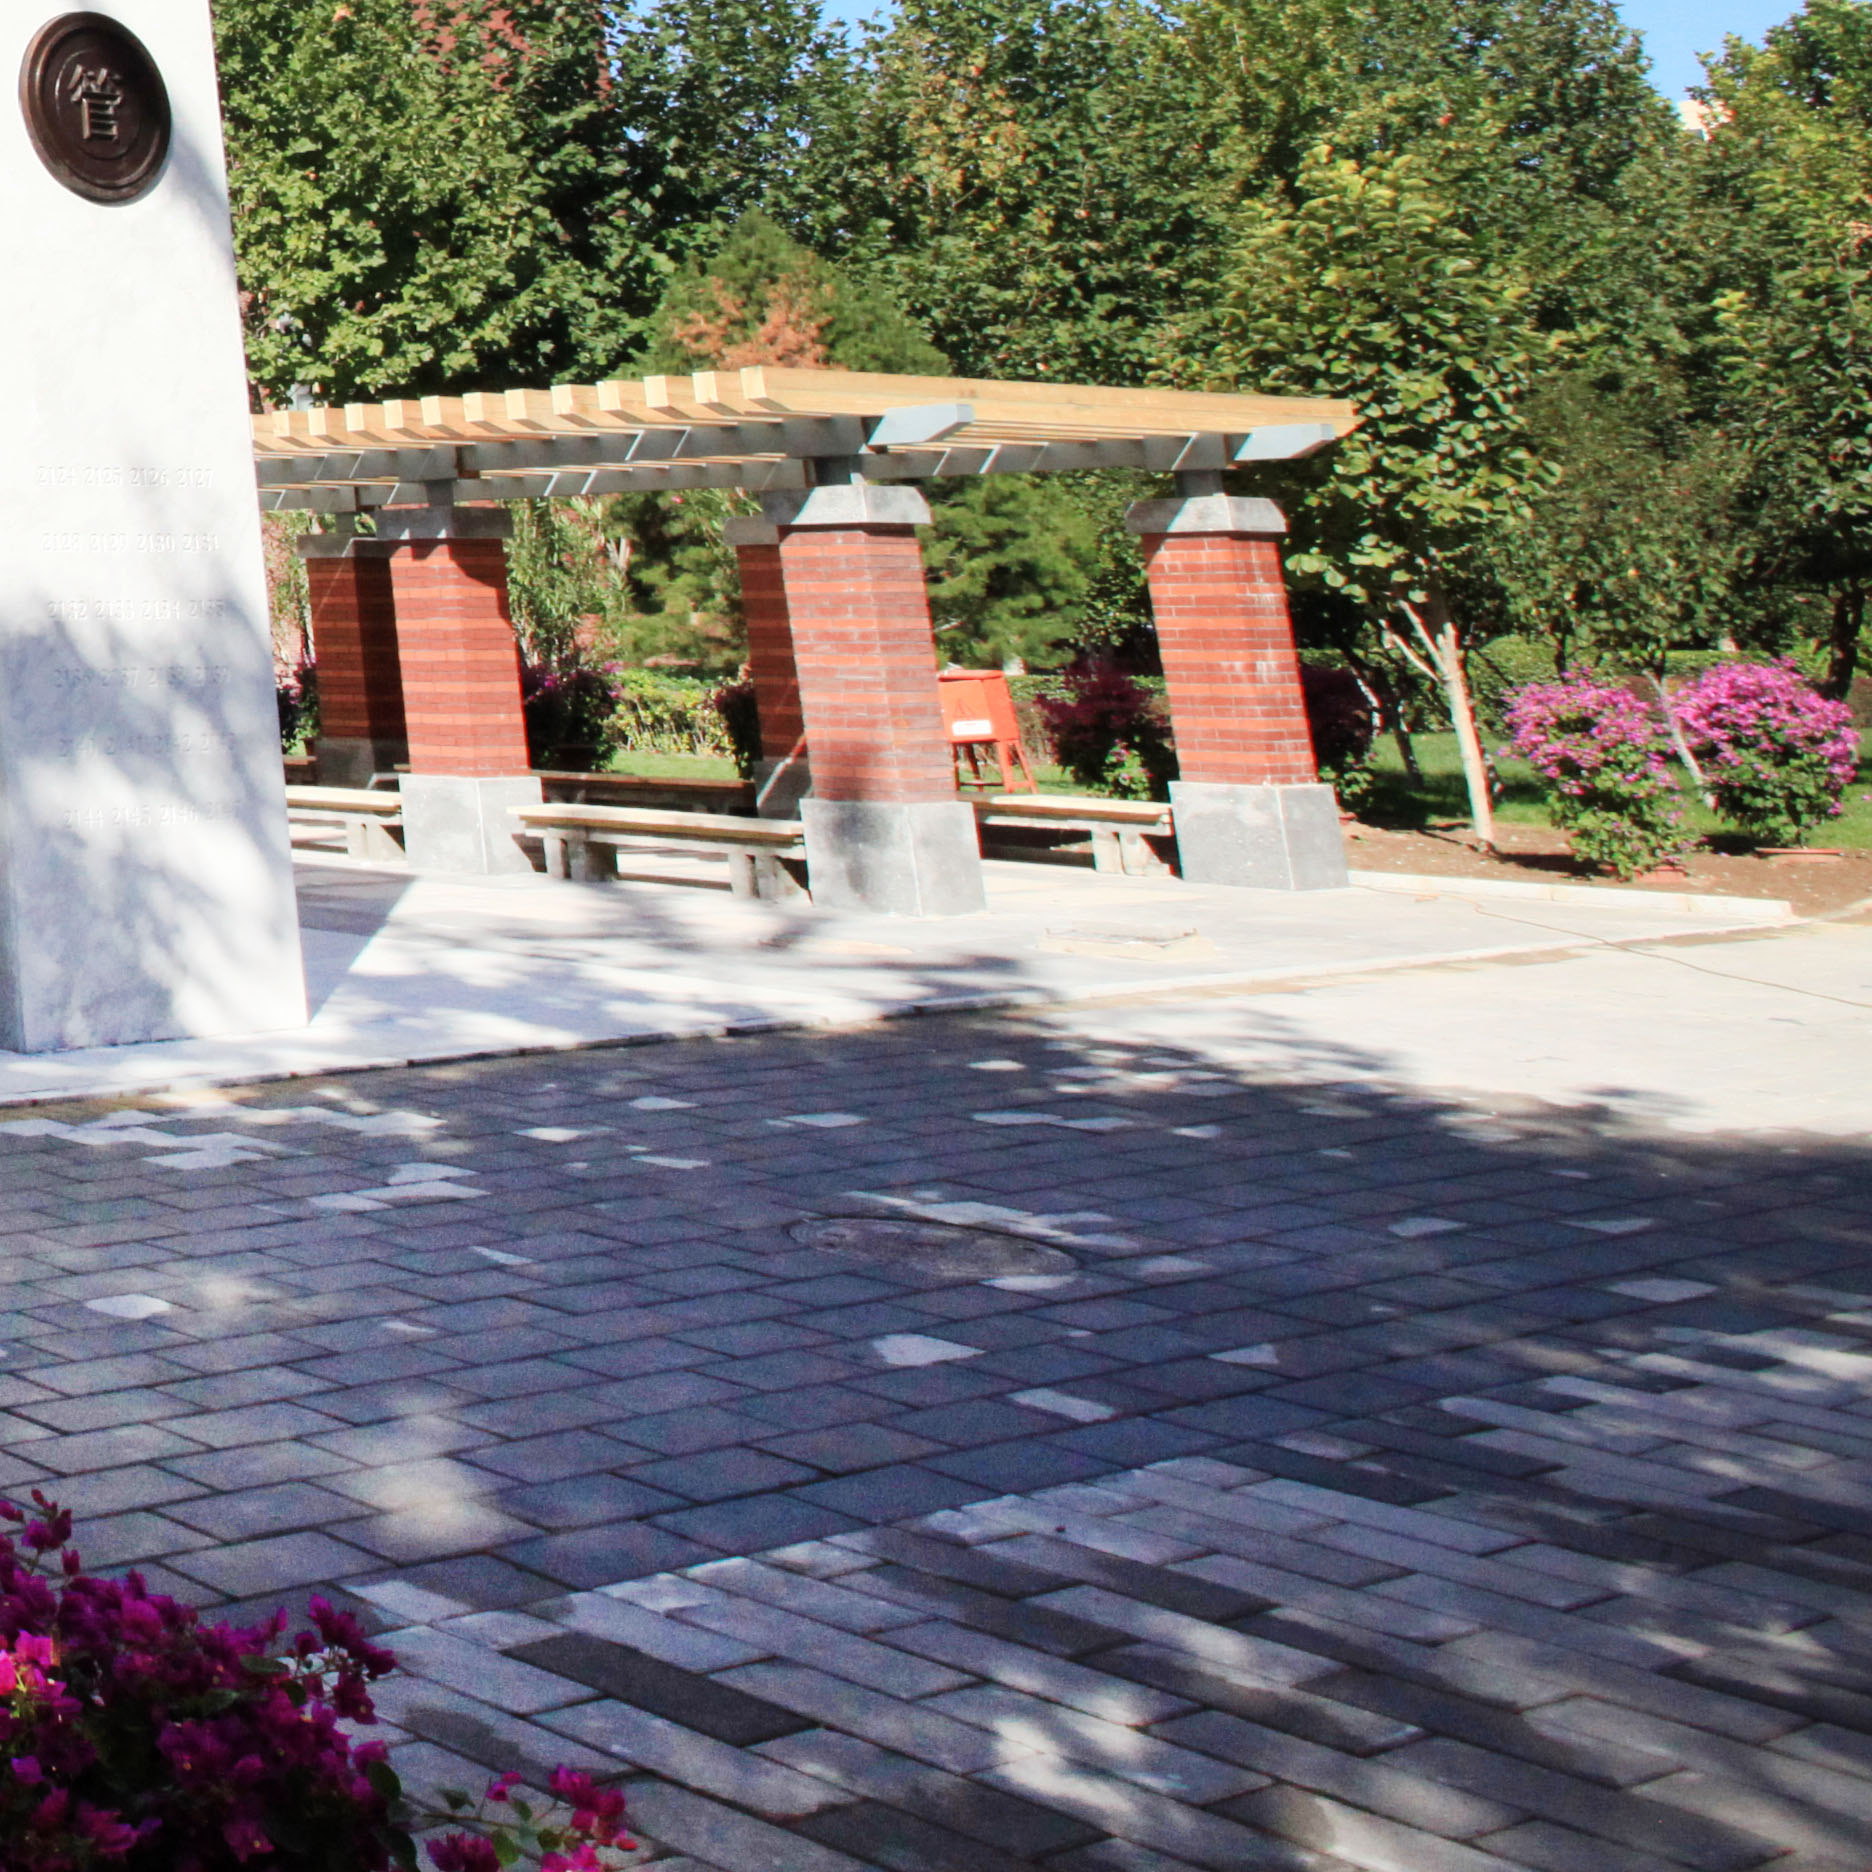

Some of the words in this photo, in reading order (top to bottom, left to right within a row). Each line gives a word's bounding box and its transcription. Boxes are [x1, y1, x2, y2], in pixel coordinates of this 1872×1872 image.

[67, 64, 123, 142] 管
[37, 465, 77, 487] 2124
[83, 465, 123, 488] 2125
[128, 466, 170, 488] 2126
[175, 468, 214, 488] 2127
[41, 532, 81, 551] 2128
[135, 531, 176, 553] 2130
[182, 532, 220, 551] 2131
[48, 600, 88, 620] 2132
[95, 600, 135, 619] 2133
[141, 599, 180, 619] 2134
[188, 598, 226, 617] 2135
